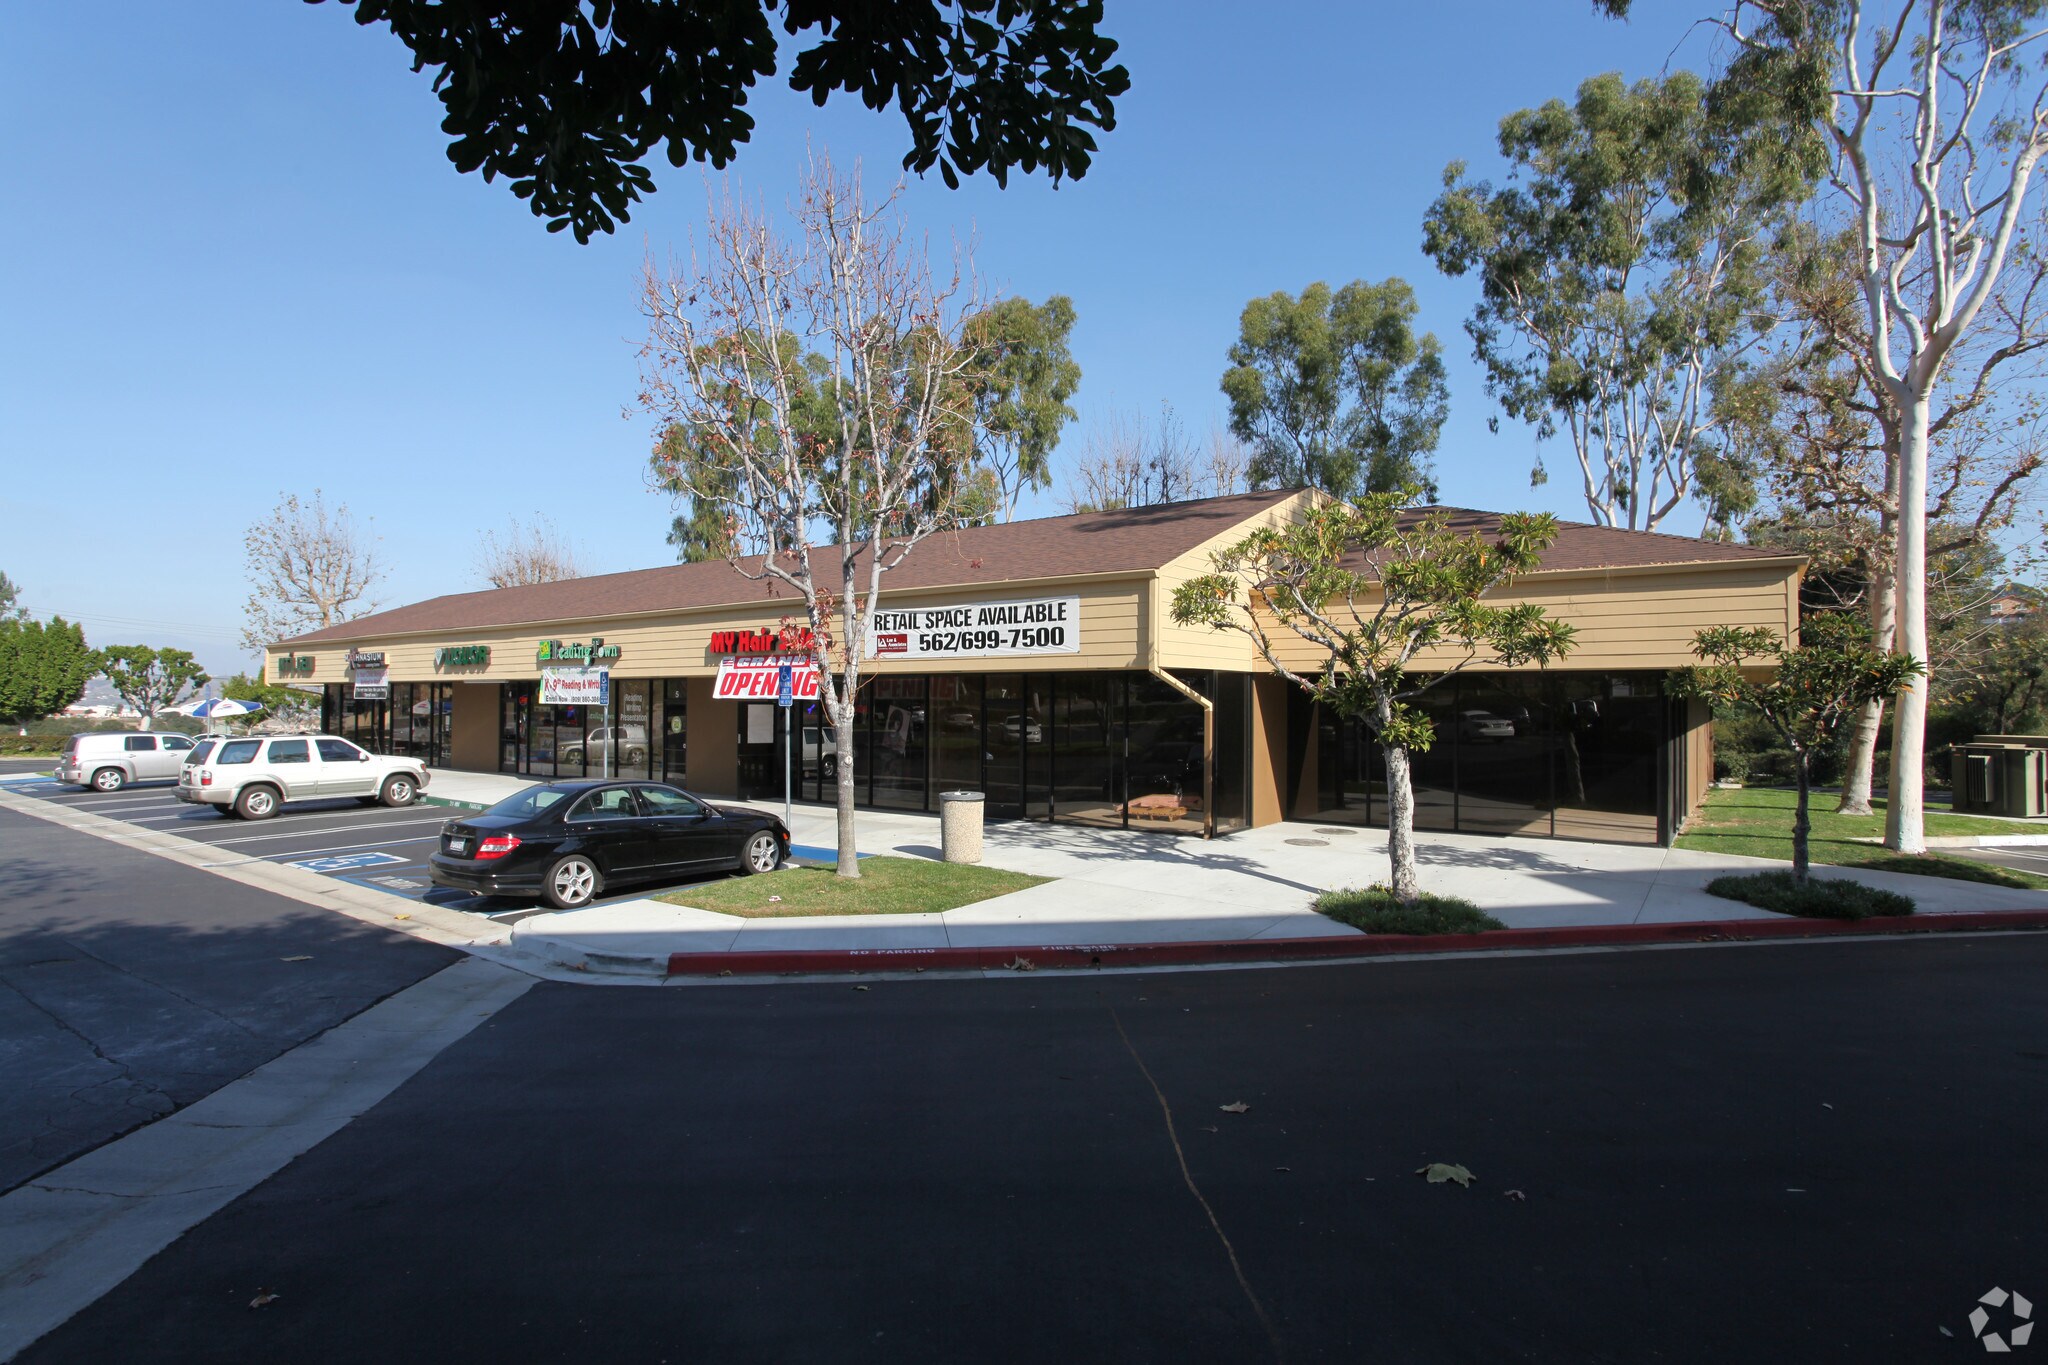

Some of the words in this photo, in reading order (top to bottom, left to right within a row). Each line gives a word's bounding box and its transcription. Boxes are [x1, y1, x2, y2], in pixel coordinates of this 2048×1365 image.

[874, 613, 920, 631] RETAIL
[925, 609, 972, 629] SPACE
[978, 602, 1067, 625] AVAILABLE
[710, 631, 735, 653] MY
[738, 627, 774, 652] Hair
[919, 626, 1064, 652] 562/699-7500
[444, 645, 488, 666] LIQUOR
[736, 654, 807, 667] GRAND
[562, 679, 581, 691] Reading
[674, 690, 680, 698] 5
[719, 671, 818, 697] OPENNG
[1001, 688, 1007, 698] 7
